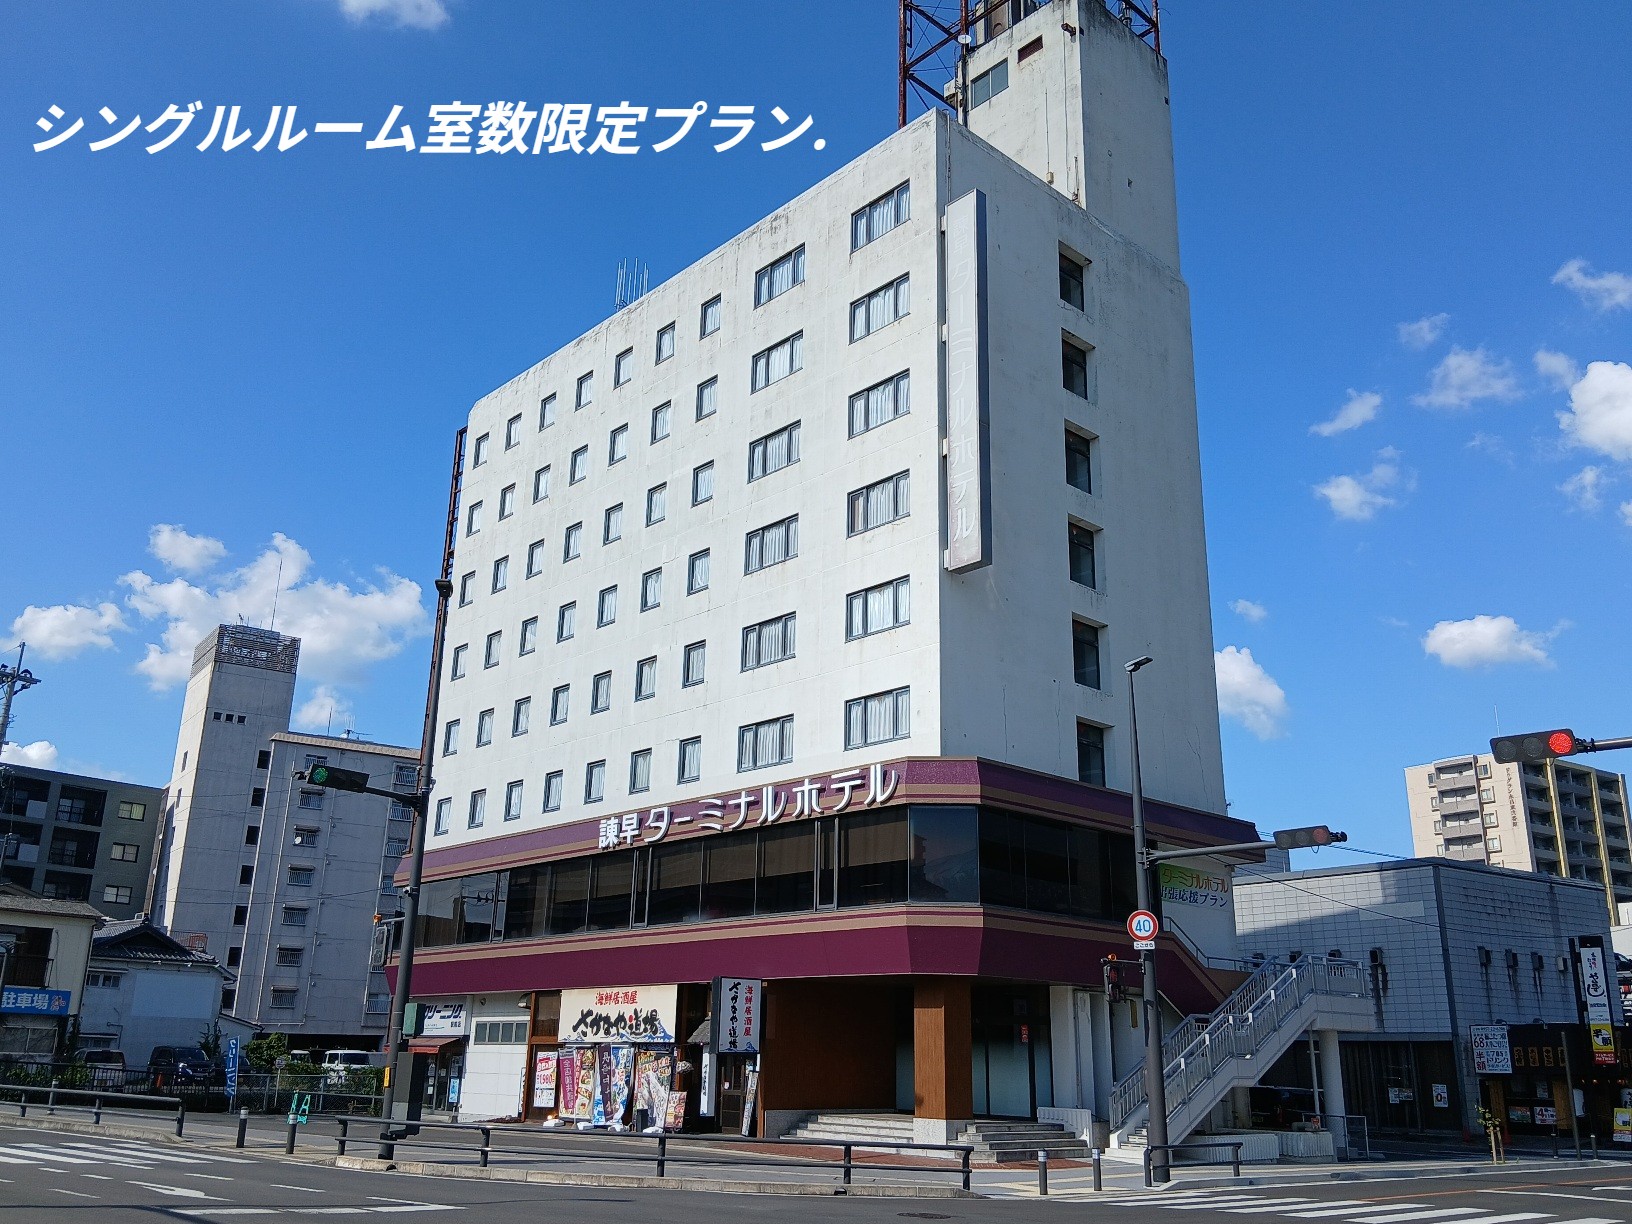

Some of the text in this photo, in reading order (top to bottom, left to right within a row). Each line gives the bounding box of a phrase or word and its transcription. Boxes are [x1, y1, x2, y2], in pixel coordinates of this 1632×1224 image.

[598, 764, 899, 849] 諫早ターミナルホテル
[1162, 868, 1229, 893] ターミナルホテル
[1135, 919, 1151, 933] 40
[1, 991, 49, 1010] 駐車場
[595, 990, 638, 1005] 海鮮居酒屋
[743, 985, 753, 1037] 海鮮居酒屋
[572, 1007, 660, 1037] さかなや道場
[729, 981, 741, 1049] さかなや道場
